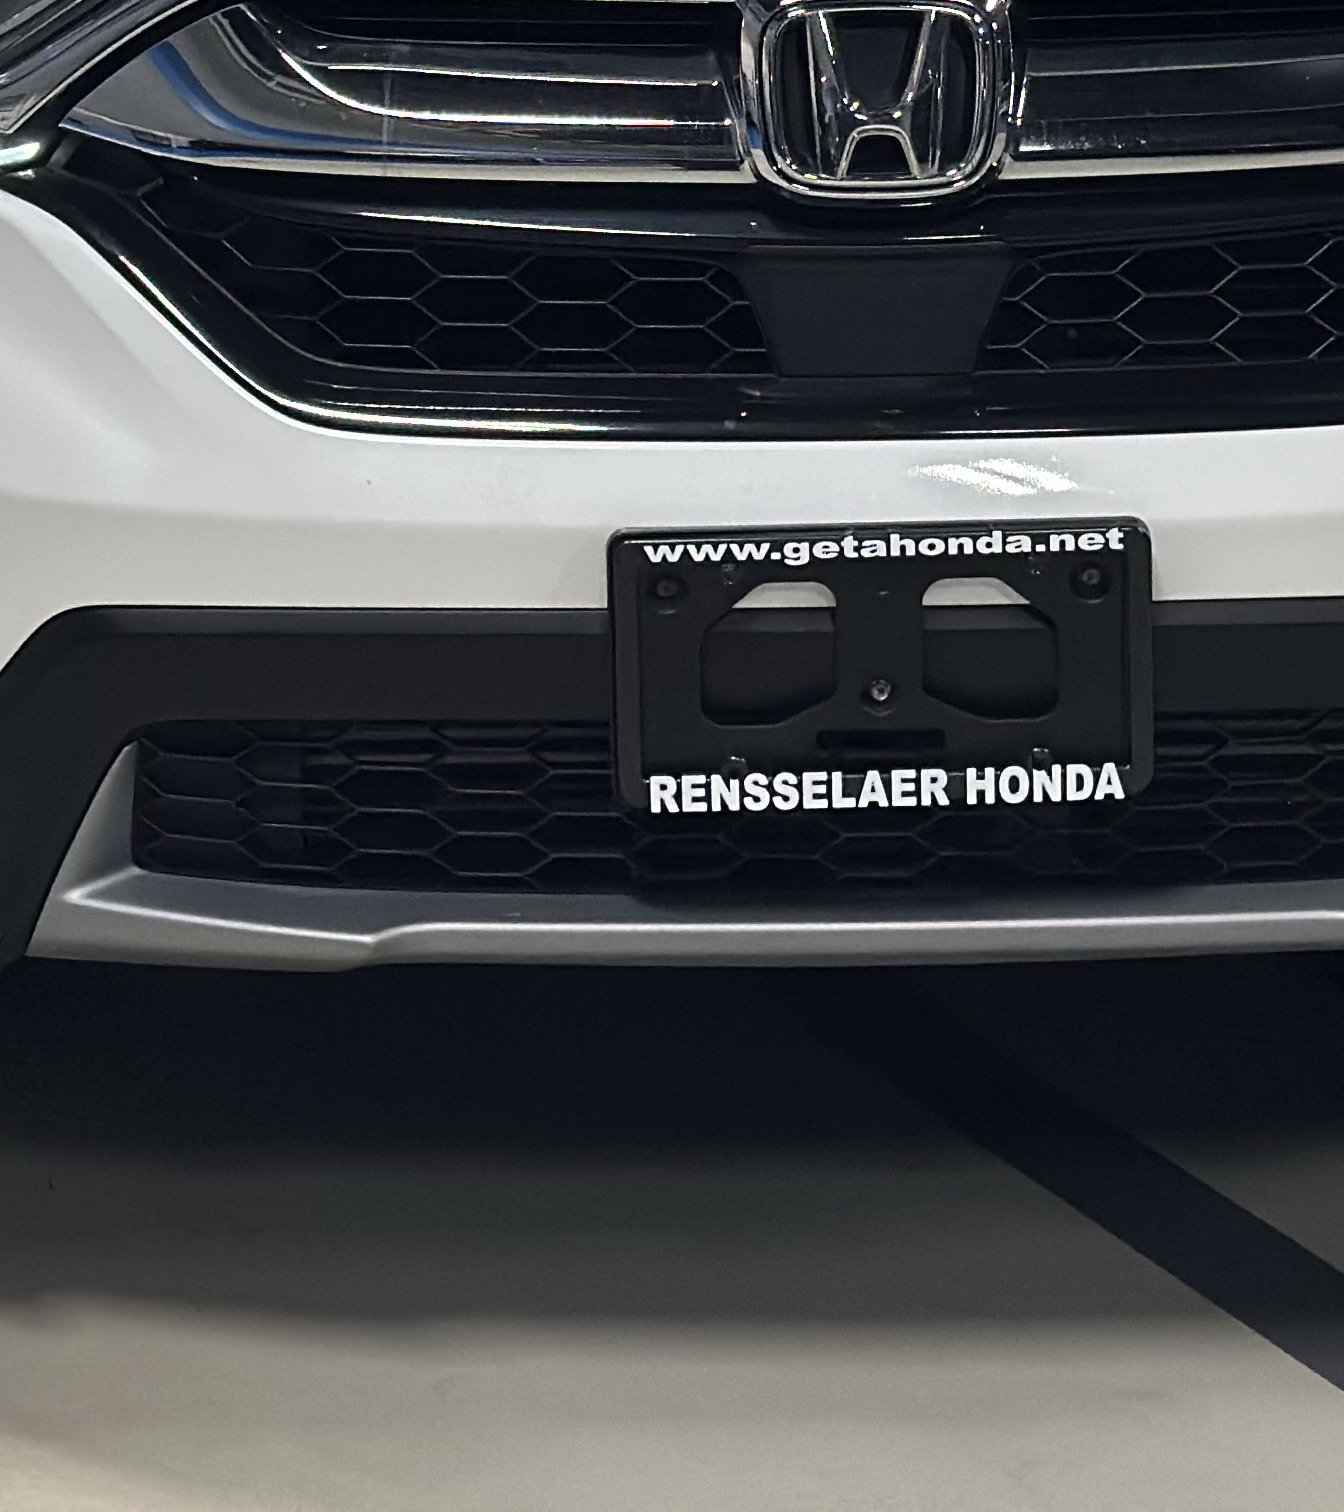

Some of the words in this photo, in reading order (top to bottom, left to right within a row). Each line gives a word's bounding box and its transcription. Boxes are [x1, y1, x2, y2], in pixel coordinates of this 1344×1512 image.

[642, 527, 1126, 566] www.getahonda.net
[648, 768, 951, 814] RENSSELAER
[965, 762, 1127, 805] HONDA
